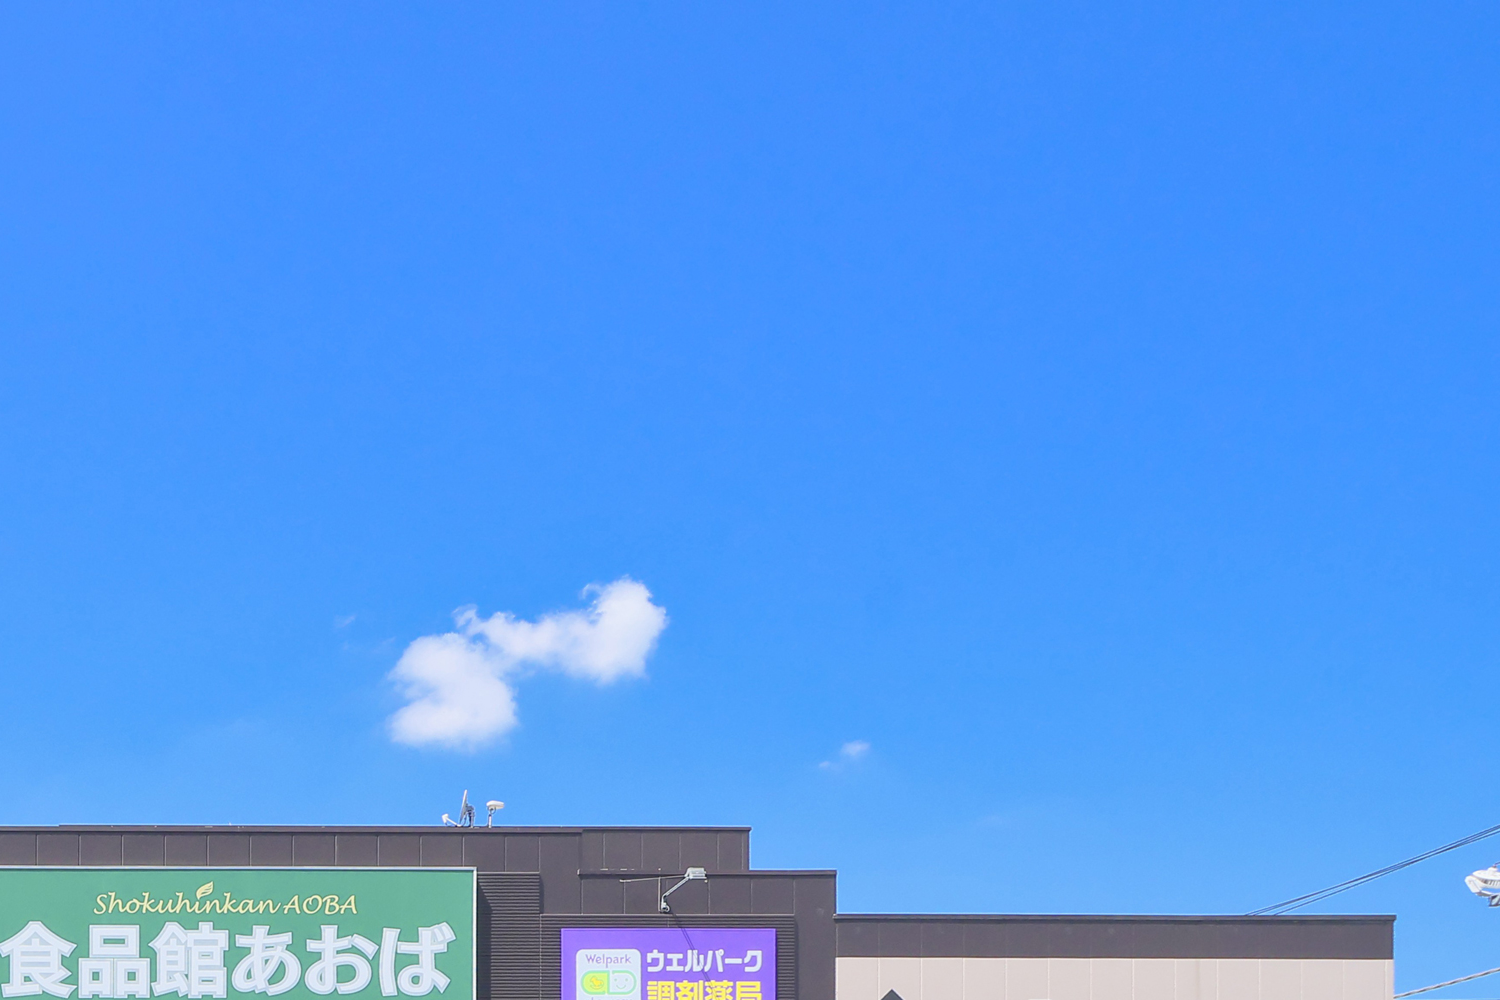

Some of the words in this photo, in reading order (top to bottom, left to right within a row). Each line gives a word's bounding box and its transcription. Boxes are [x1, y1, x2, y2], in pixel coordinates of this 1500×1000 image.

[93, 890, 282, 915] Shokuhinkan
[283, 894, 358, 915] AOBA
[585, 953, 632, 968] Welpark
[646, 949, 763, 973] ウェルパーク
